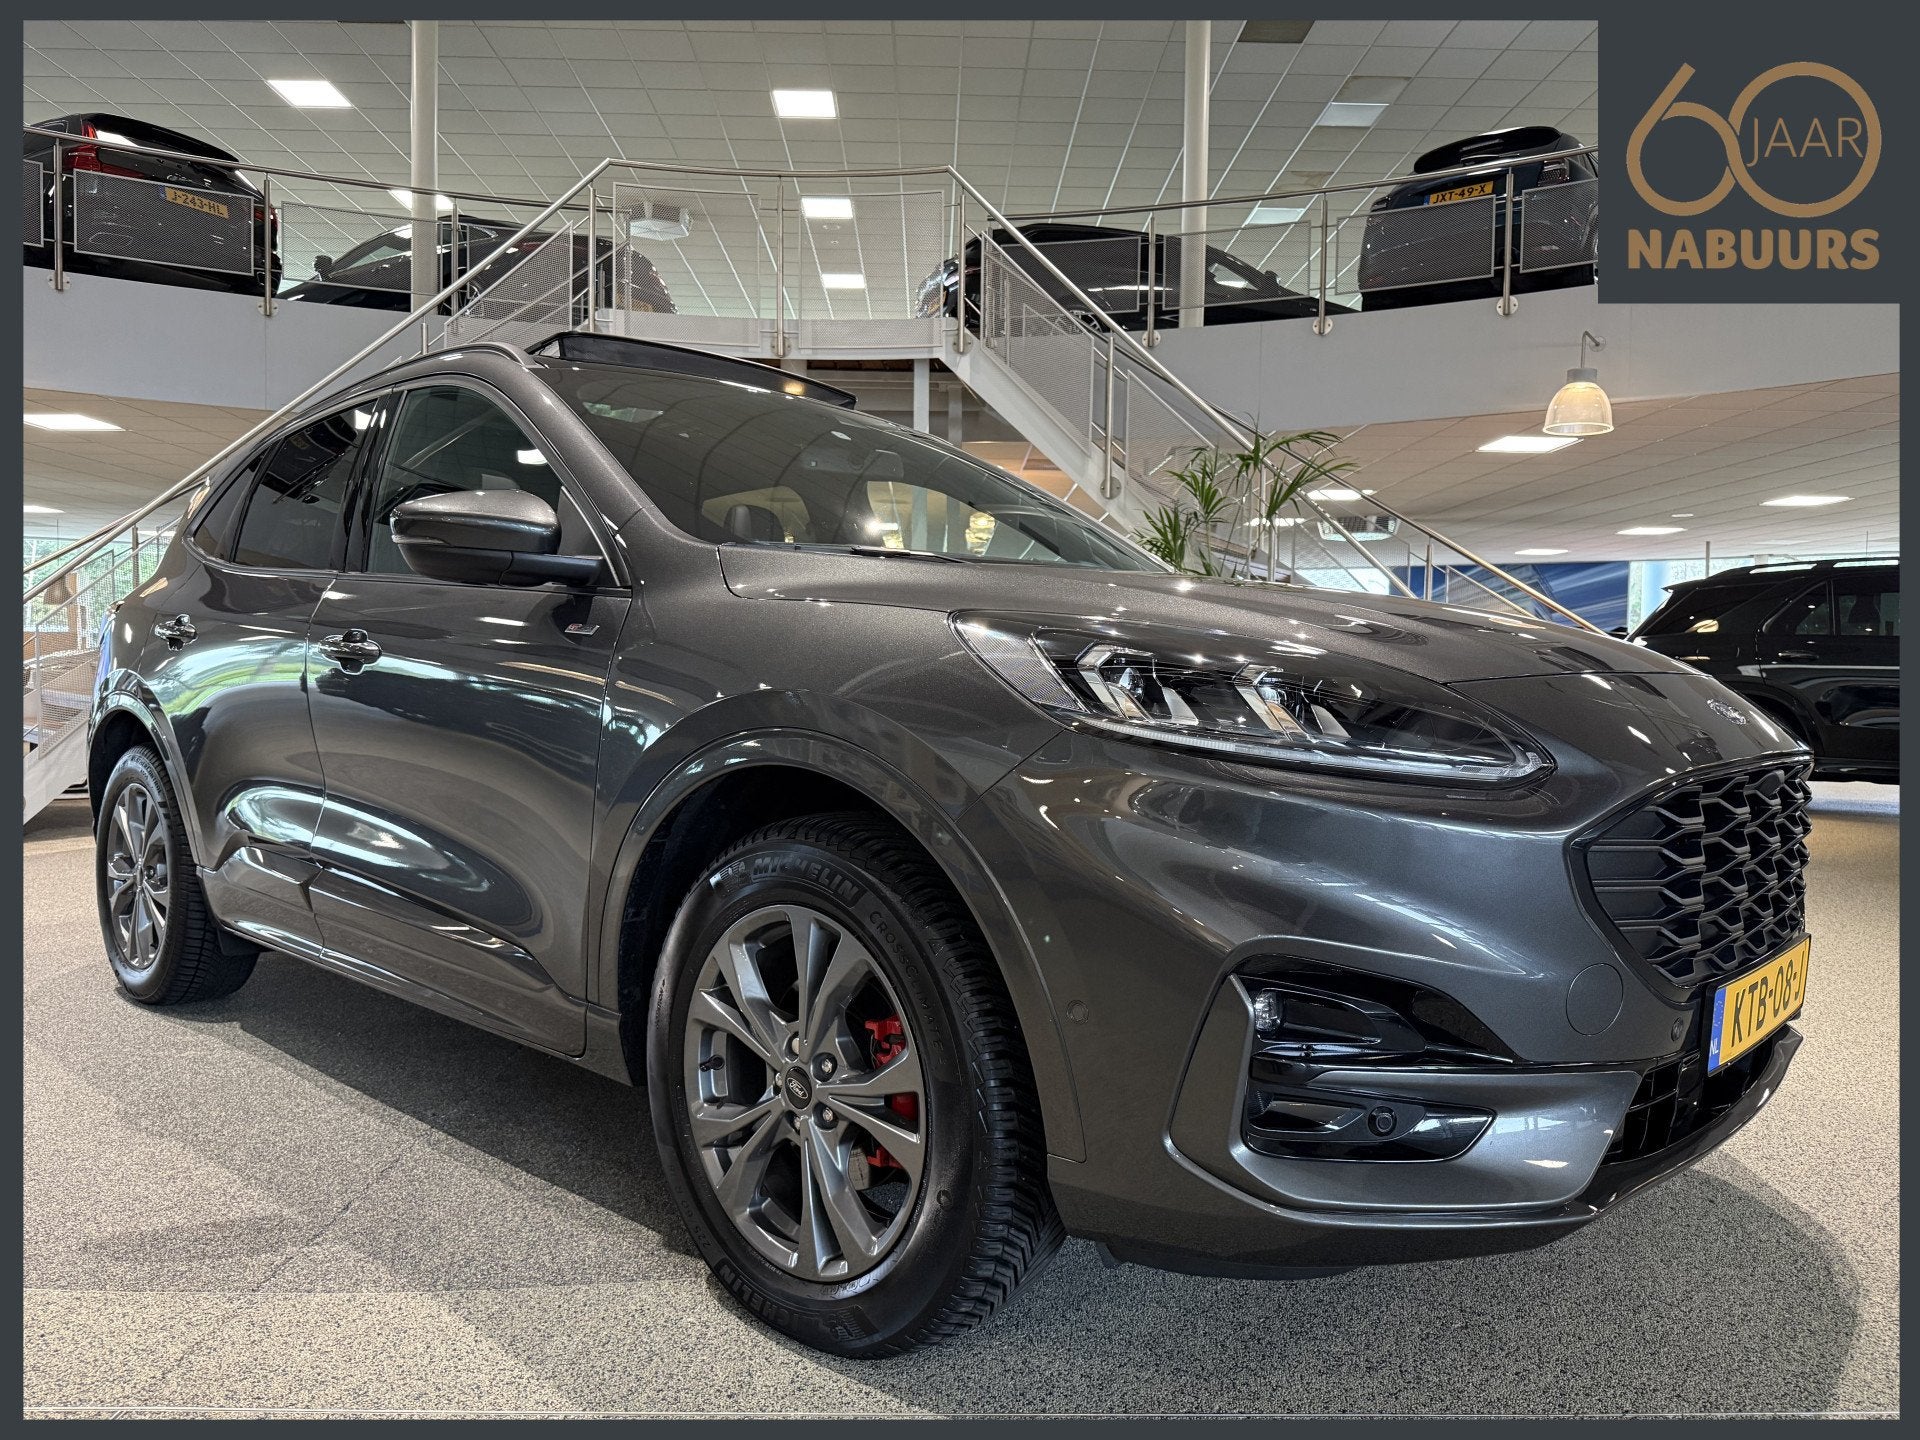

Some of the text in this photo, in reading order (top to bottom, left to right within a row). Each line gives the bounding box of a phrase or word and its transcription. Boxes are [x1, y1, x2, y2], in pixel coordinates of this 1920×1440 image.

[172, 190, 224, 215] J-243-HL
[1432, 184, 1487, 204] JXT-49-X
[753, 856, 860, 901] MICHELIN
[1731, 950, 1805, 1048] KTB-08-J
[1710, 1039, 1719, 1057] NL
